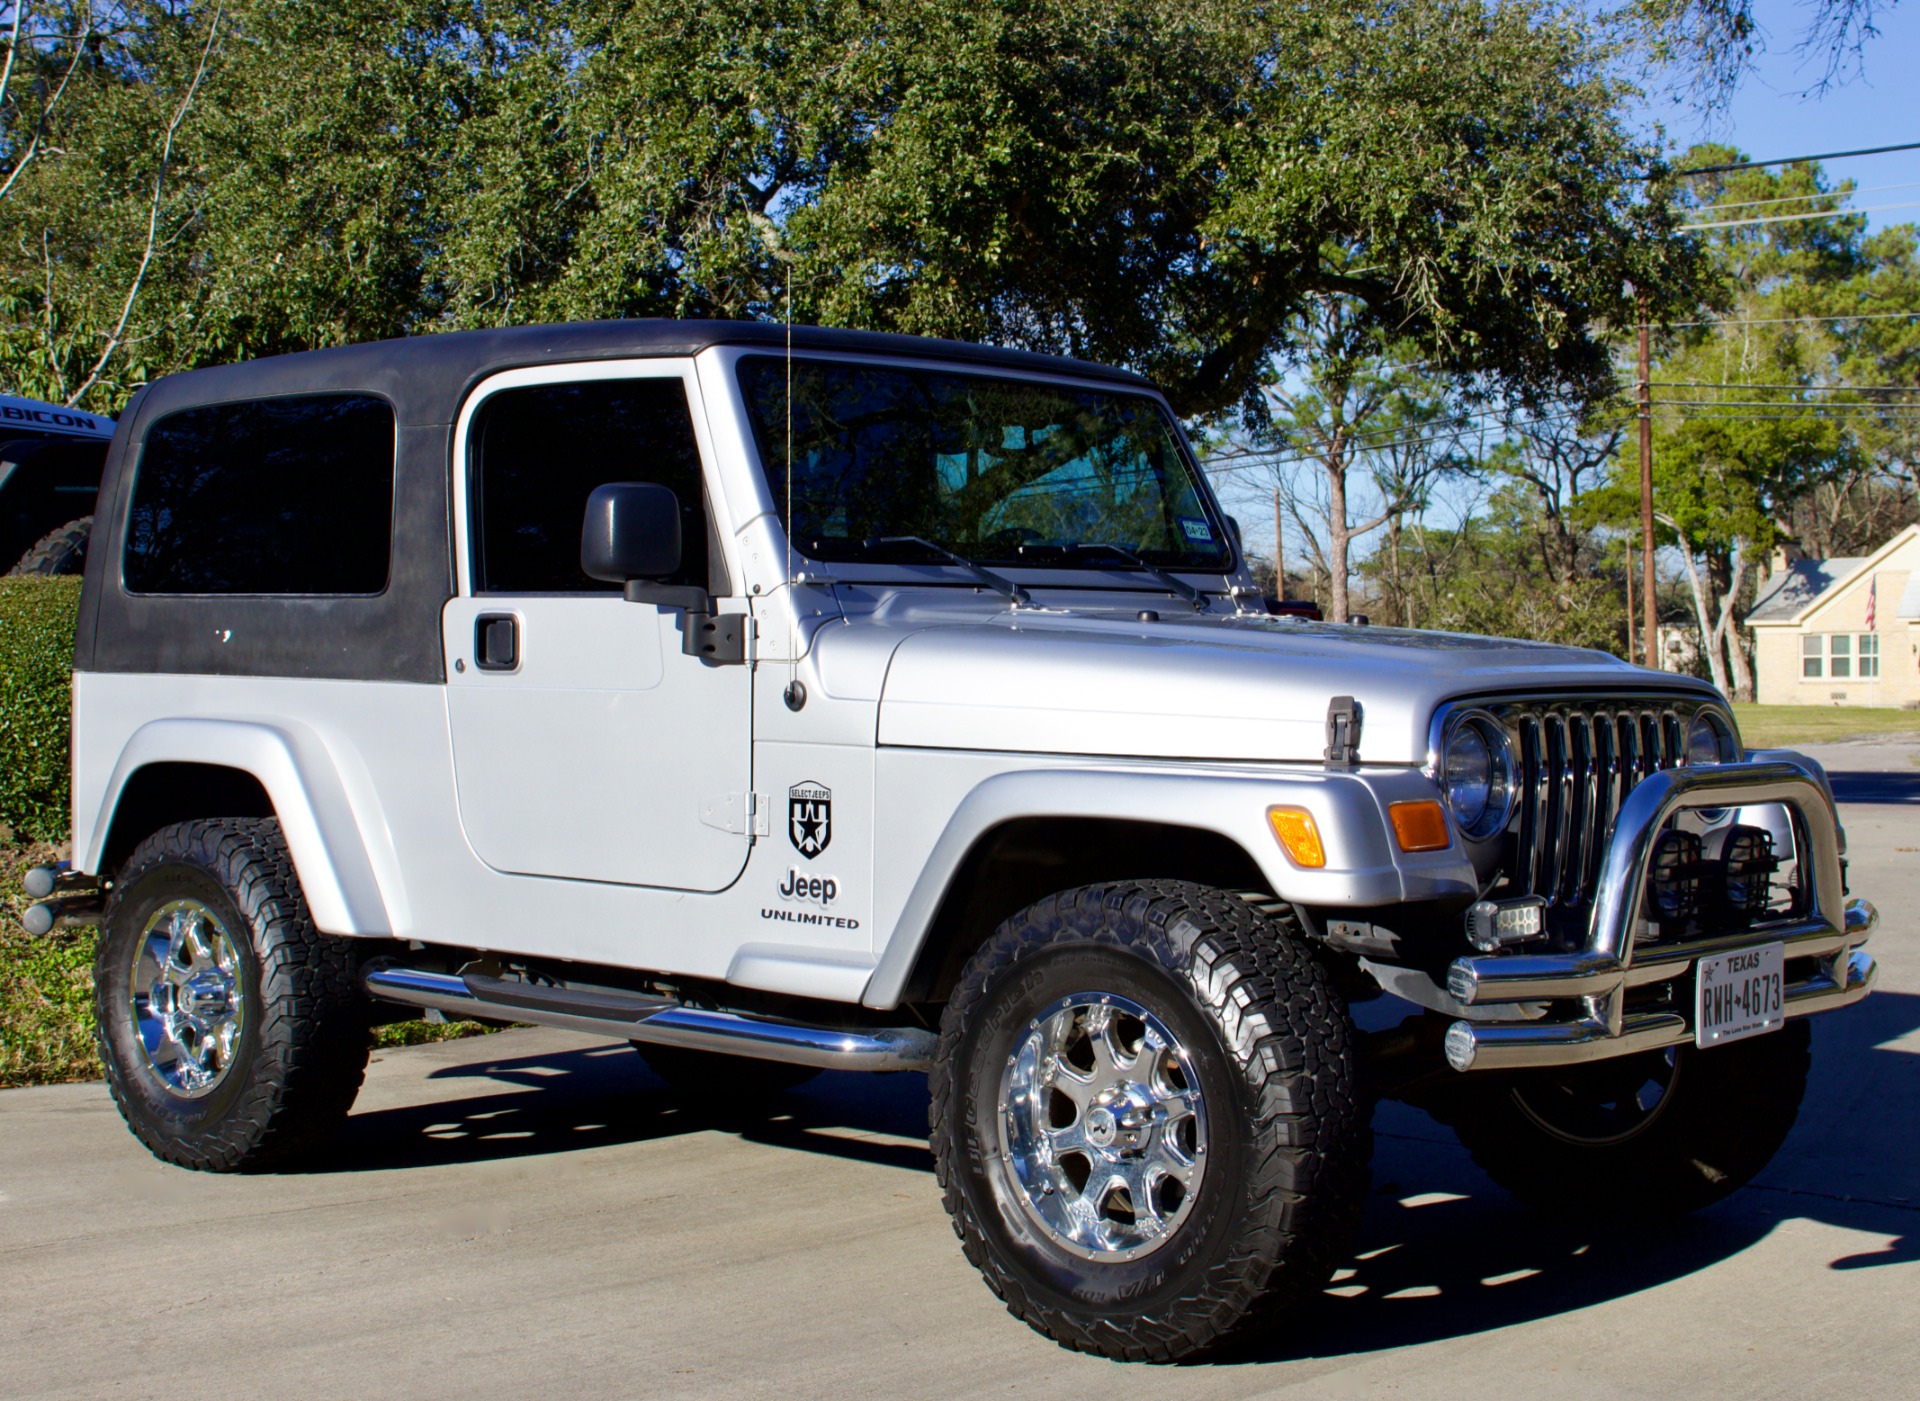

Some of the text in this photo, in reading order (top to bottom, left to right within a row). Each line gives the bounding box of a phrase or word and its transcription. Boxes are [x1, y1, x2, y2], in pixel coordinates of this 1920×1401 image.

[0, 406, 96, 430] BICON
[780, 870, 837, 904] Jeep
[761, 908, 860, 930] UNLIMITED
[1727, 952, 1760, 974] TEXAS
[1703, 973, 1780, 1028] RWH 4673
